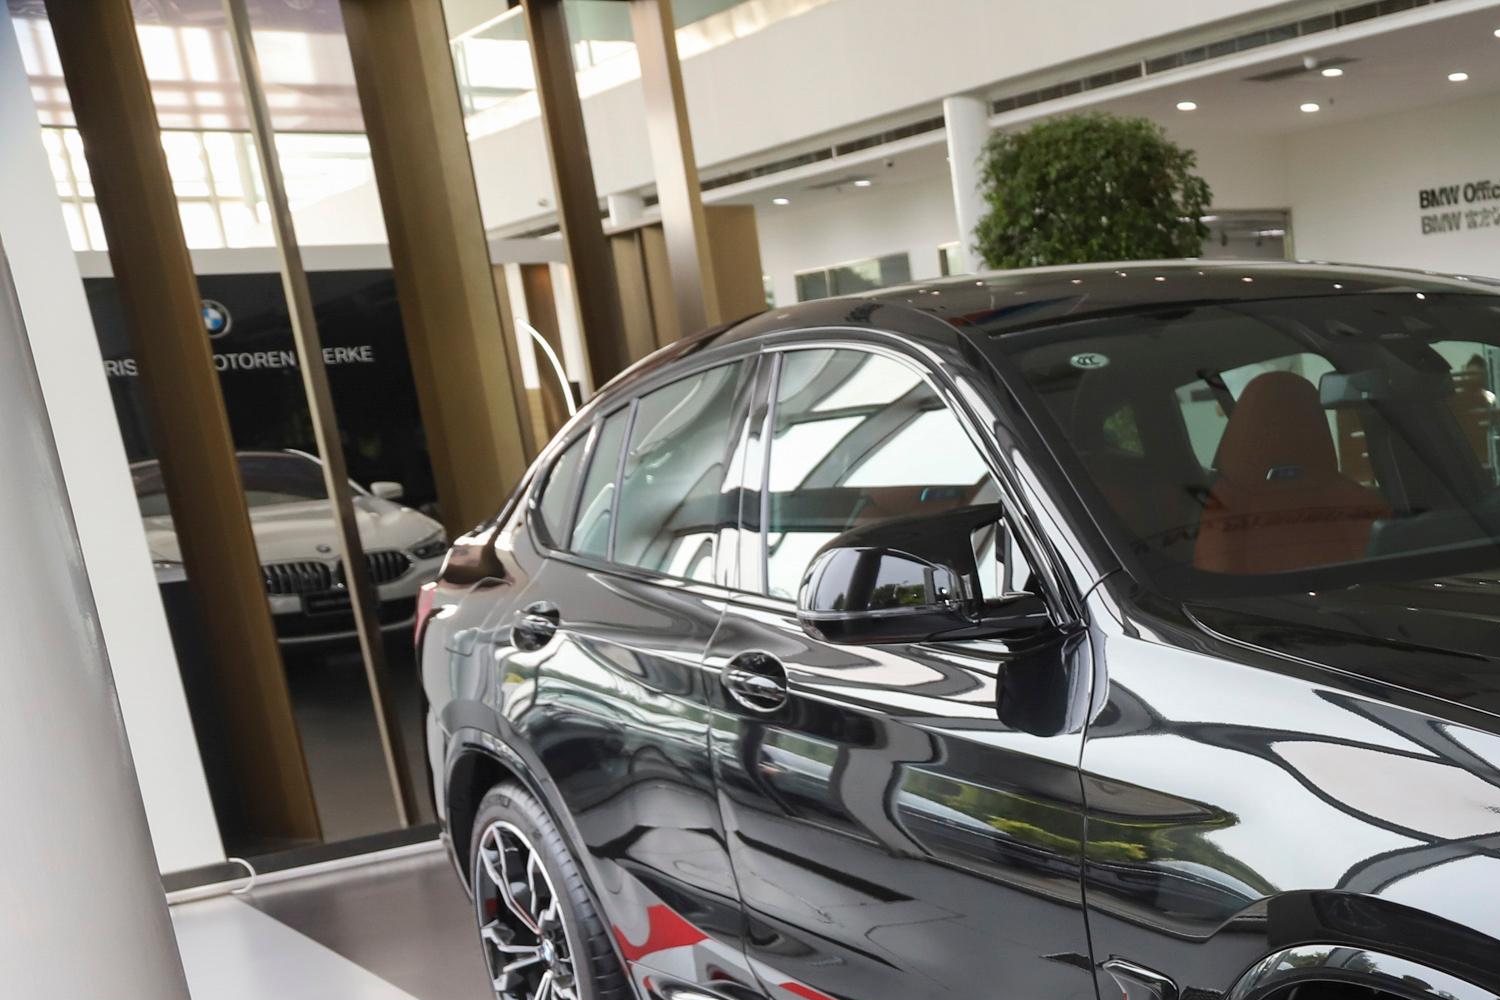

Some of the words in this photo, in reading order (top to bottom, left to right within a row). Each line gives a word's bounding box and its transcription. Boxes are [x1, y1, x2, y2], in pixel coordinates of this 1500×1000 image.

[1419, 184, 1460, 209] BMW
[1421, 211, 1461, 235] BMW
[213, 350, 296, 371] OTOREN
[322, 344, 375, 364] ERKE
